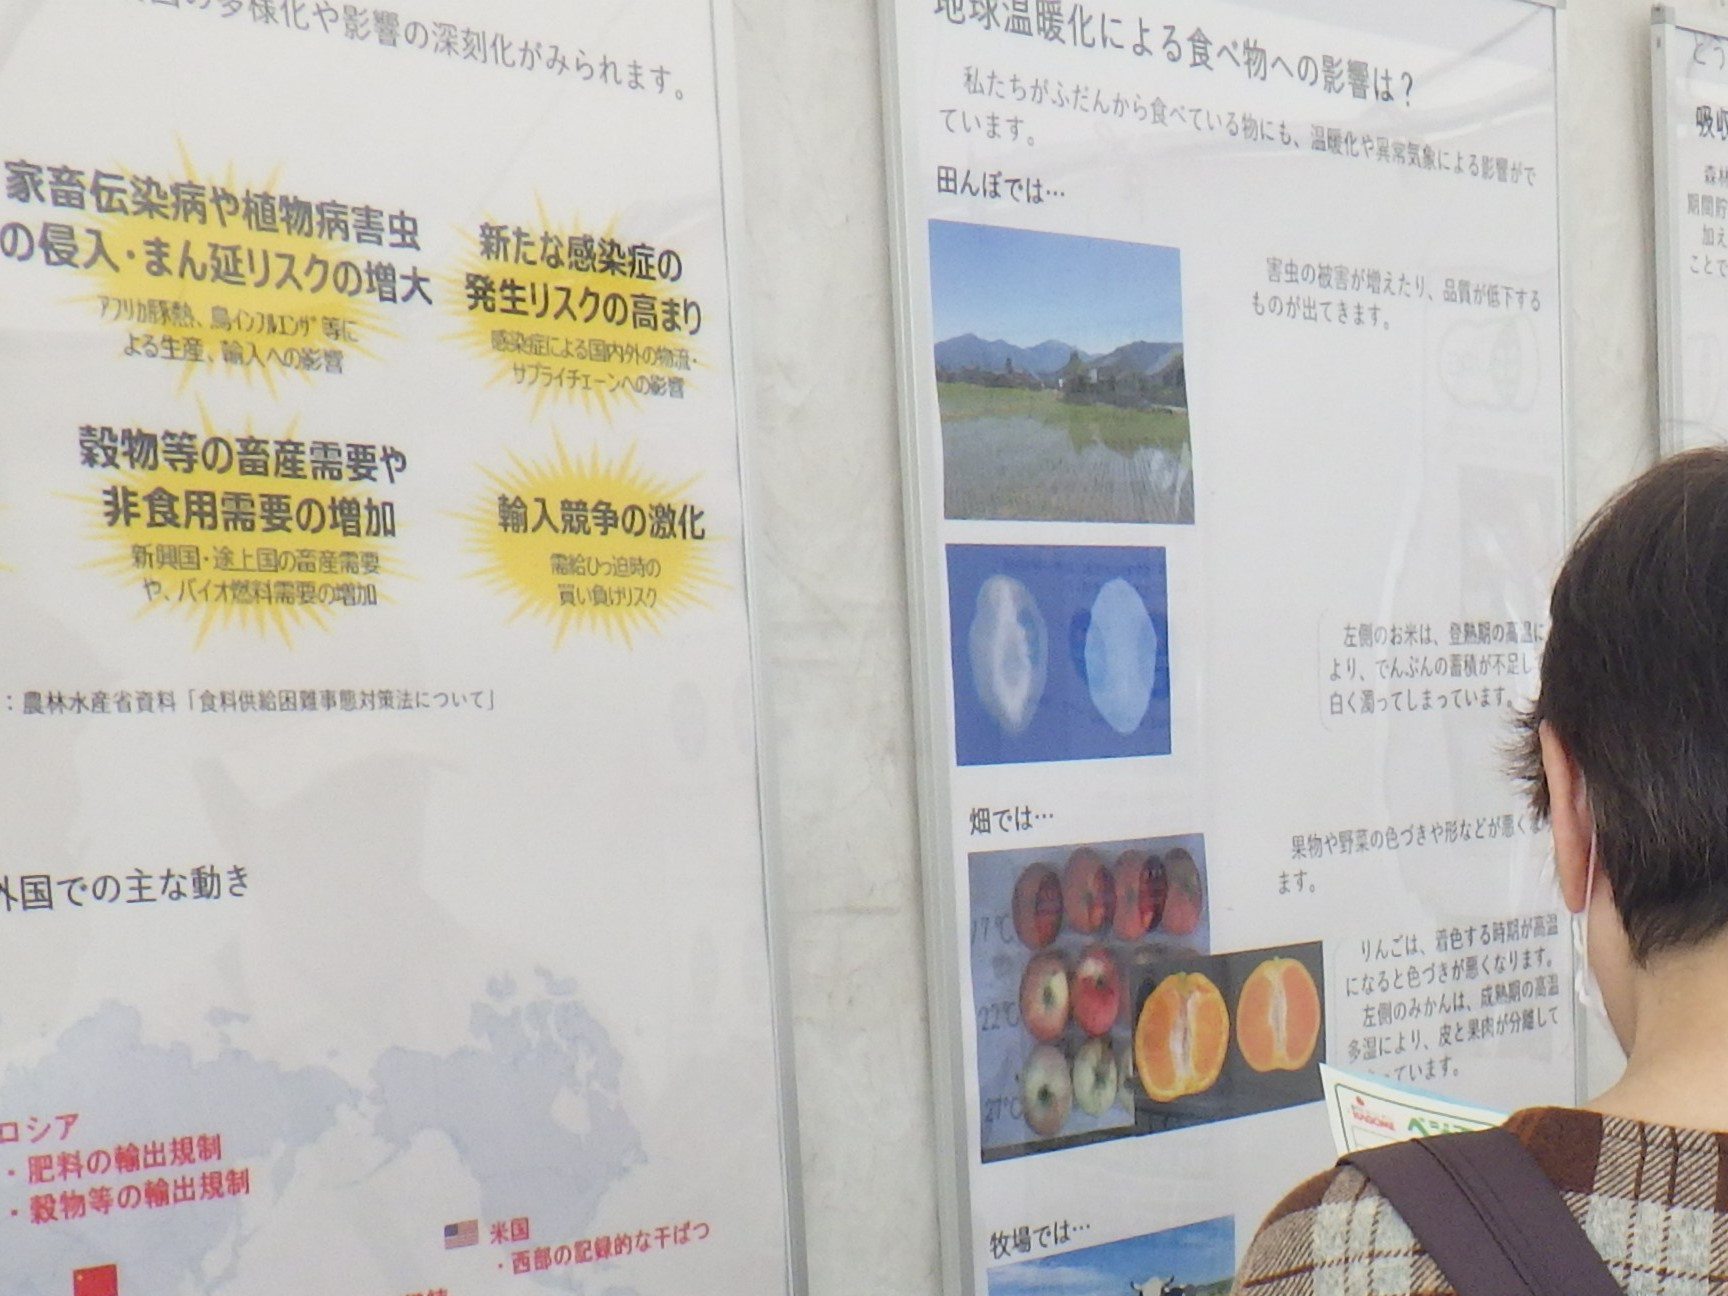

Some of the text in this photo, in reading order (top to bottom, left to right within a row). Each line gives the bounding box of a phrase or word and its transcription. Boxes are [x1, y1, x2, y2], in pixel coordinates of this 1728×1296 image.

[136, 0, 686, 101] 多様化や影響の深刻化がみられます。
[939, 108, 1035, 147] ています。
[4, 158, 423, 252] 家畜伝染病や植物病害虫
[0, 220, 434, 306] の侵入・まん延リスクの増大
[478, 222, 683, 283] 新たな感染症の
[465, 271, 702, 336] 発生リスクの高まり
[78, 425, 407, 484] 穀物等の畜産需要や
[102, 485, 397, 538] 非食用需要の増加
[497, 493, 706, 541] 輸入競争の激化
[1278, 868, 1316, 896] ます。
[0, 1113, 79, 1144] ロシア
[490, 1217, 530, 1245] 米国
